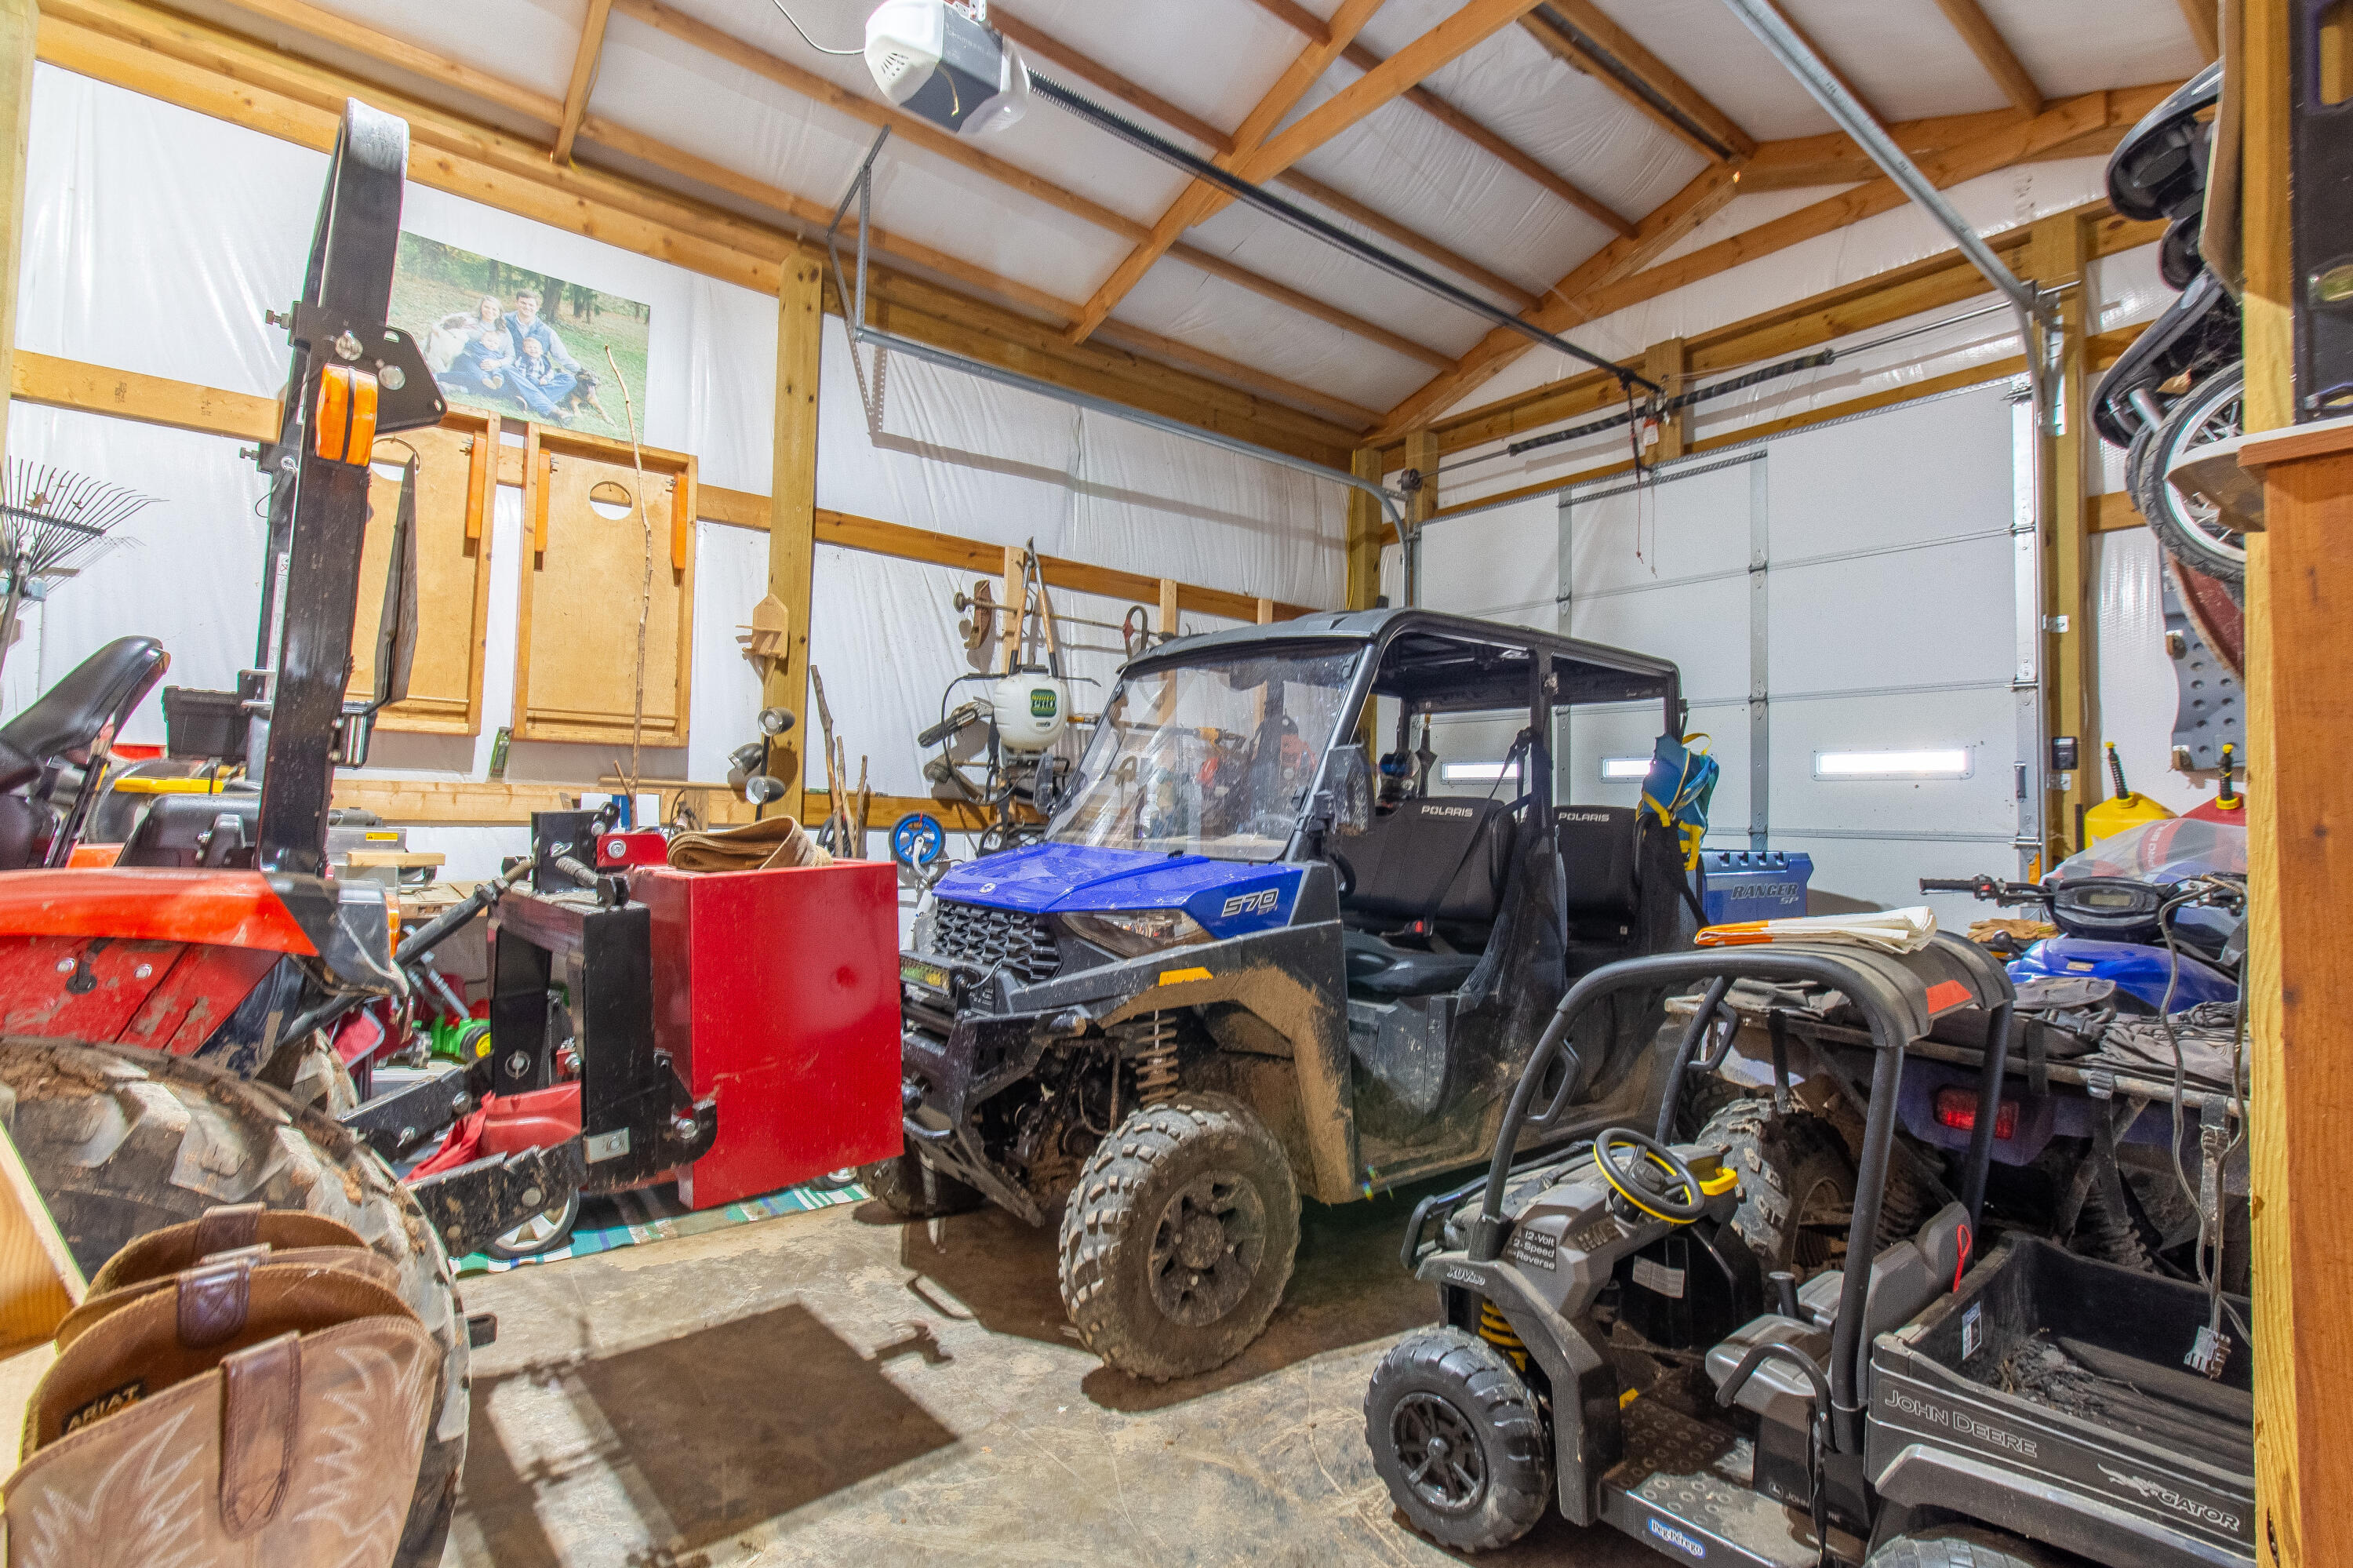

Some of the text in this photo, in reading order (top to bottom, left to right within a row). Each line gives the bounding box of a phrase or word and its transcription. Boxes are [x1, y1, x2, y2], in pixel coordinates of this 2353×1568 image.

[1421, 805, 1474, 817] POLARIS
[1558, 812, 1610, 822] POLARIS
[1730, 882, 1799, 900] RANGER
[1780, 896, 1800, 904] SP
[1221, 888, 1279, 917] 570
[1516, 1250, 1555, 1270] Reverse
[67, 1384, 139, 1433] ARIAT
[1886, 1390, 2037, 1458] JOHN DEERE
[1786, 1491, 1809, 1508] JOHN
[2157, 1491, 2240, 1532] GATOR
